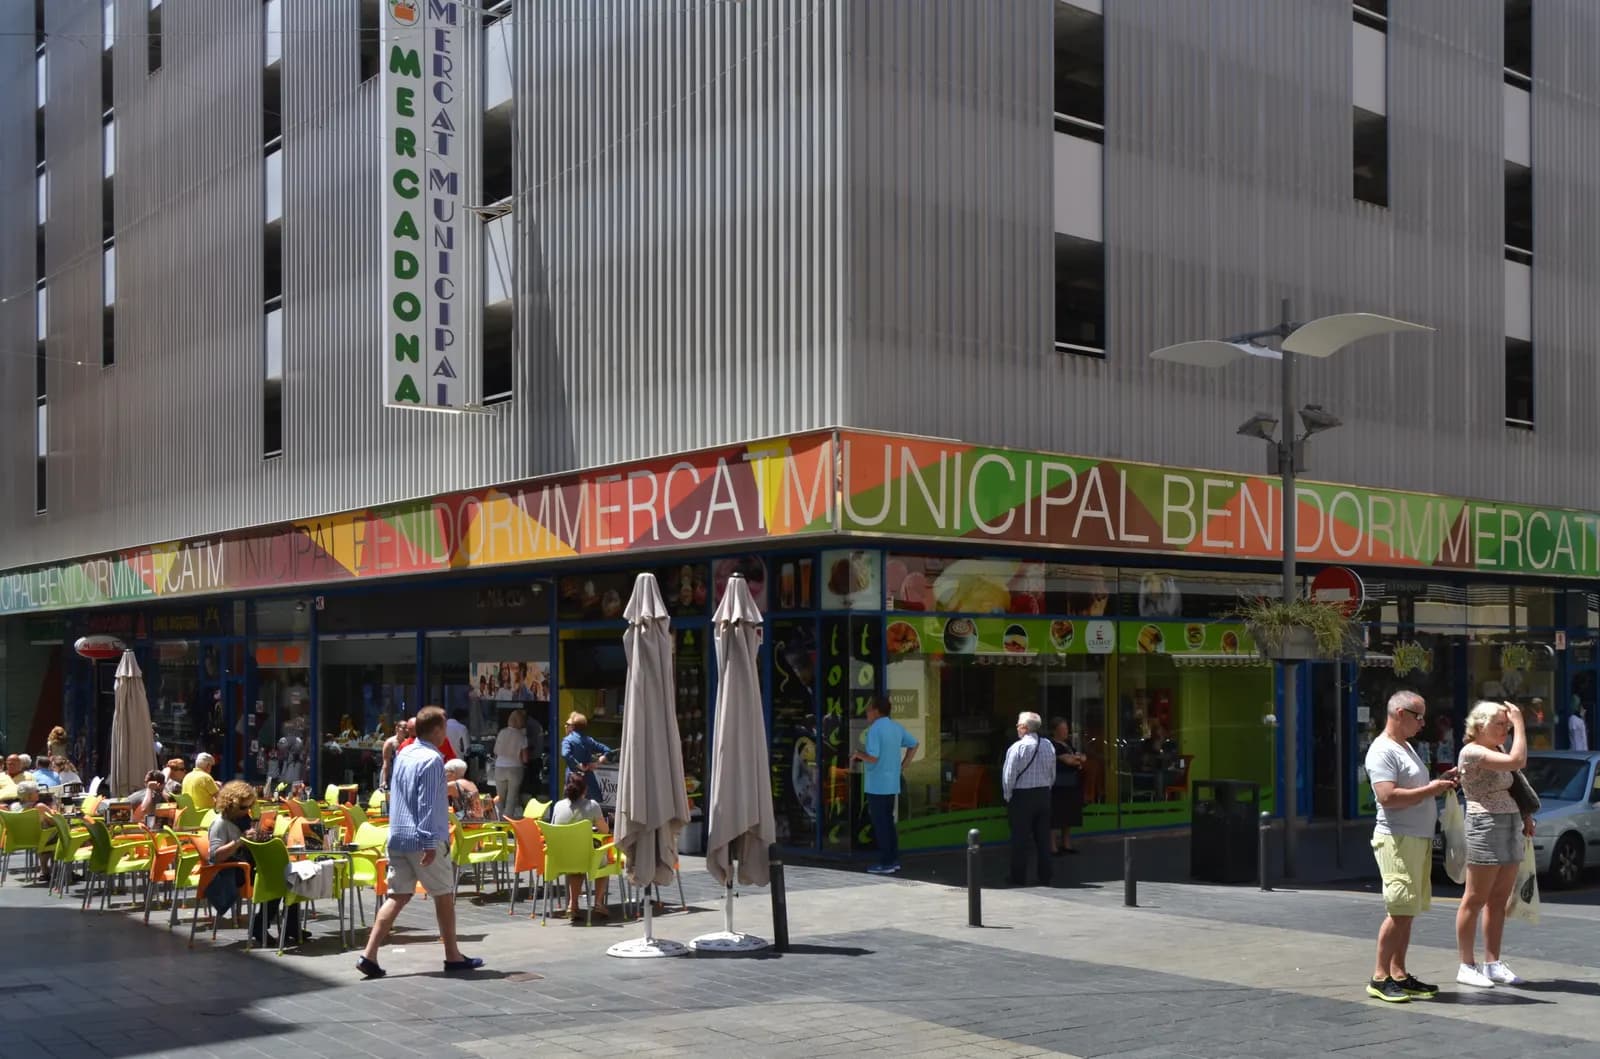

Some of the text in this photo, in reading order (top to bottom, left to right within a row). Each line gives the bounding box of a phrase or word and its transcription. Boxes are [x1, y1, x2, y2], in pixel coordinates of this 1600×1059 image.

[388, 44, 422, 404] MERCADONA
[428, 0, 459, 408] MERCAT MUNICIPAL
